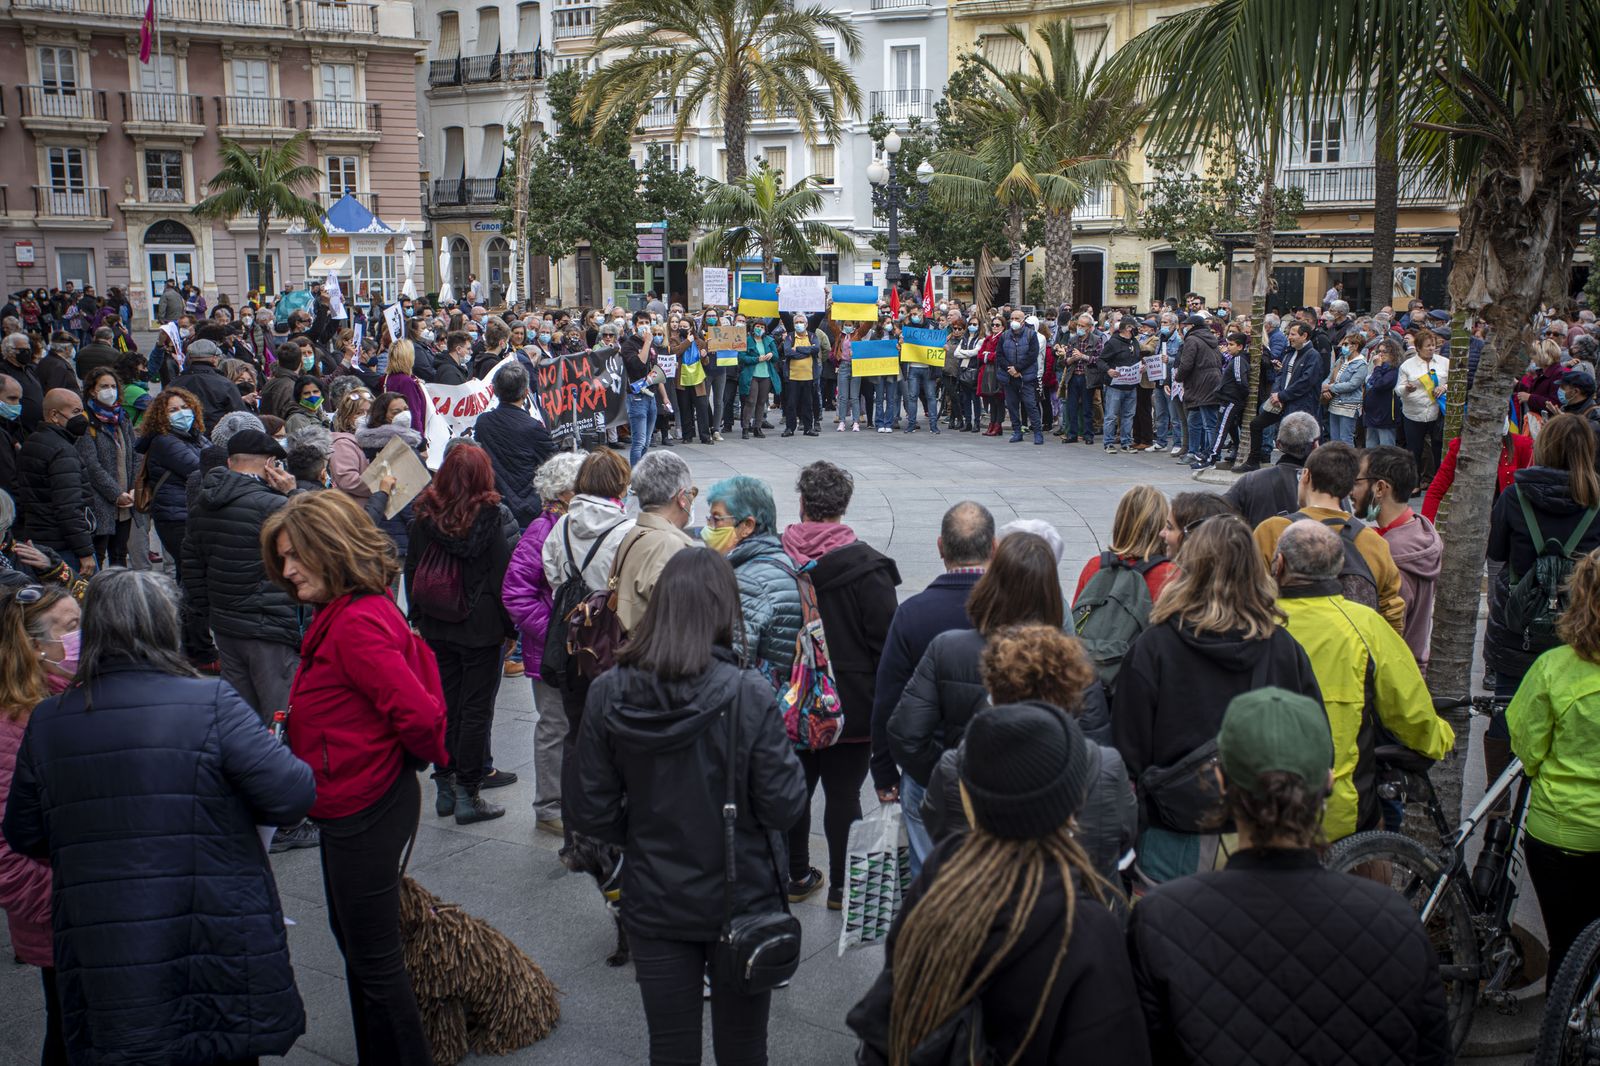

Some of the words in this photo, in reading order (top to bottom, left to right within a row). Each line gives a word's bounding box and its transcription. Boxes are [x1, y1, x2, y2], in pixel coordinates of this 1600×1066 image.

[906, 329, 947, 341] UCRANIA
[926, 348, 944, 360] PAZ
[538, 364, 556, 387] NO
[561, 360, 568, 383] A
[573, 356, 592, 380] LA
[541, 380, 607, 421] GUERRA
